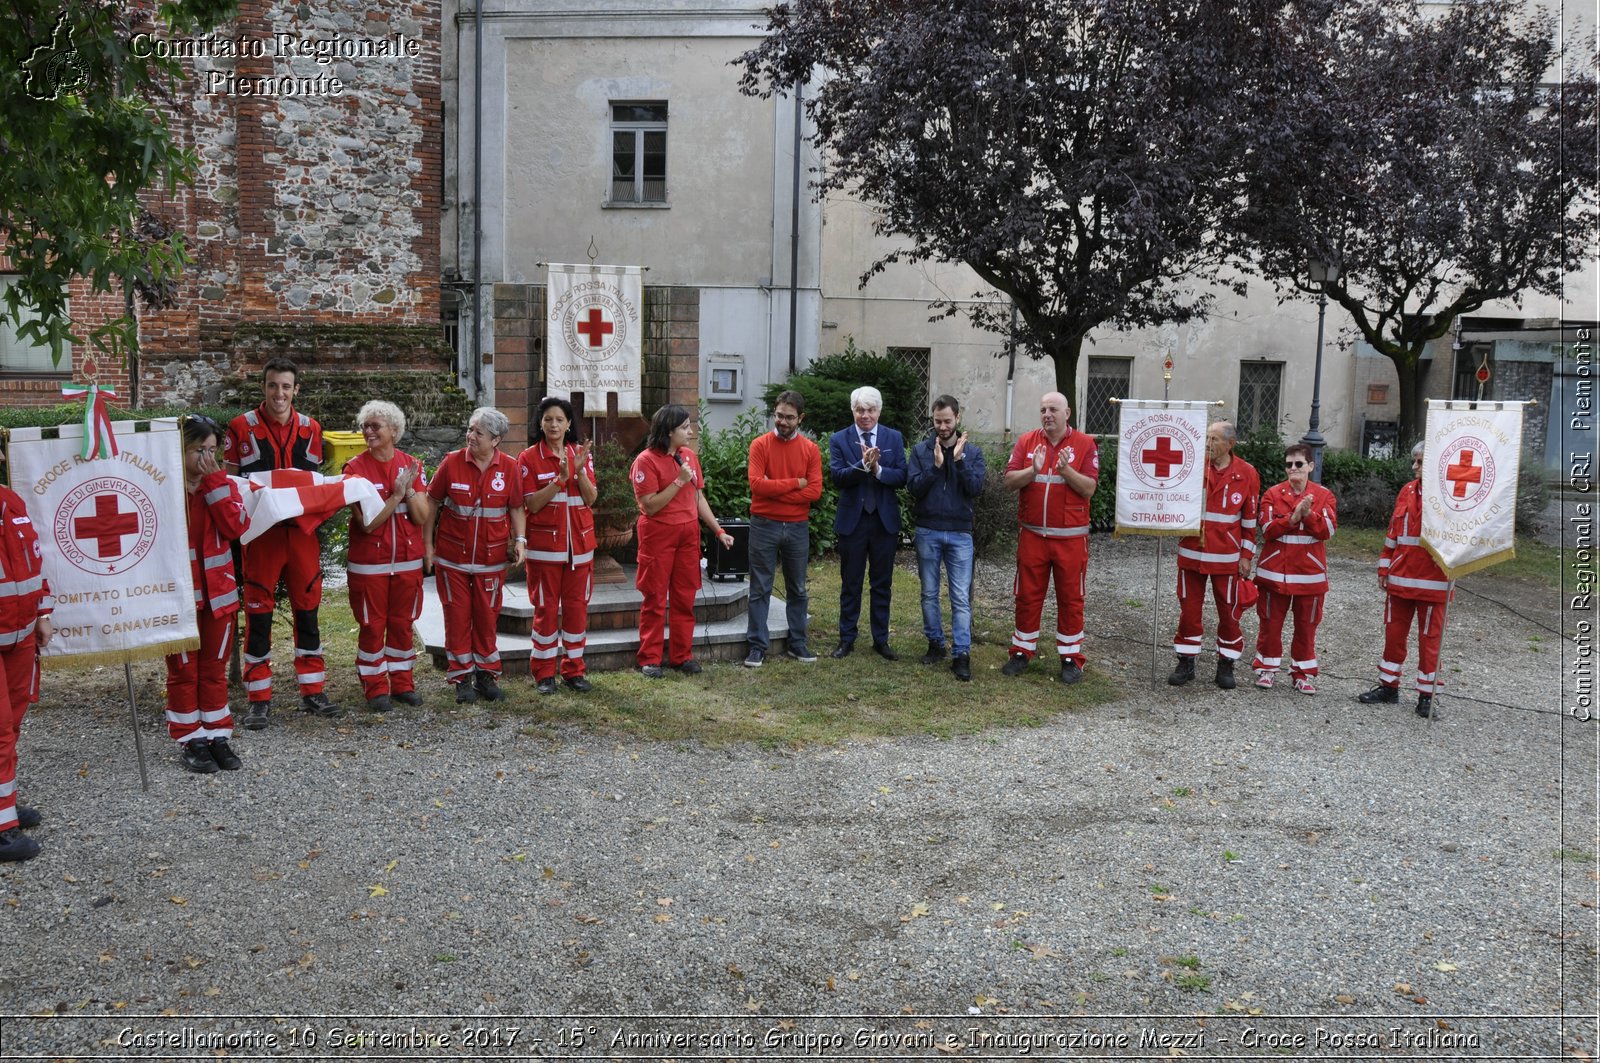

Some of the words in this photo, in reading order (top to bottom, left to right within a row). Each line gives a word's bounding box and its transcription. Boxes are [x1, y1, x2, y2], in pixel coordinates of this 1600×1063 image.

[551, 290, 574, 321] CROCE
[573, 280, 606, 296] ROSSA
[607, 284, 639, 323] ITALIANA
[560, 363, 599, 372] COMITATO
[600, 364, 629, 372] LOCALE
[554, 379, 635, 388] CASTELLAMONTE
[1124, 418, 1147, 441] CROCE
[1148, 414, 1173, 423] ROSSA
[1175, 417, 1201, 442] ITALIANA
[1132, 436, 1147, 480] CONVENZIONE
[1151, 426, 1179, 437] GINEVRA
[1184, 441, 1193, 469] AGOSTO
[120, 450, 166, 485] ITALIANA
[1483, 456, 1494, 489] AGOSTO
[33, 459, 72, 496] CROCE
[85, 480, 128, 493] GINEVRA
[73, 489, 86, 500] DI
[128, 487, 141, 498] 22
[1129, 492, 1164, 501] COMITATO
[1166, 493, 1190, 502] LOCALE
[1156, 502, 1164, 511] DI
[137, 498, 155, 540] AGOSTO
[1131, 512, 1186, 523] STRAMBINO
[1456, 512, 1493, 531] LOCALE
[1489, 502, 1503, 515] DI
[57, 494, 84, 565] CONVENZIONE
[134, 539, 150, 558] 1864
[126, 582, 177, 598] LOCALE
[111, 606, 122, 616] DI
[101, 614, 179, 635] CANAVESE
